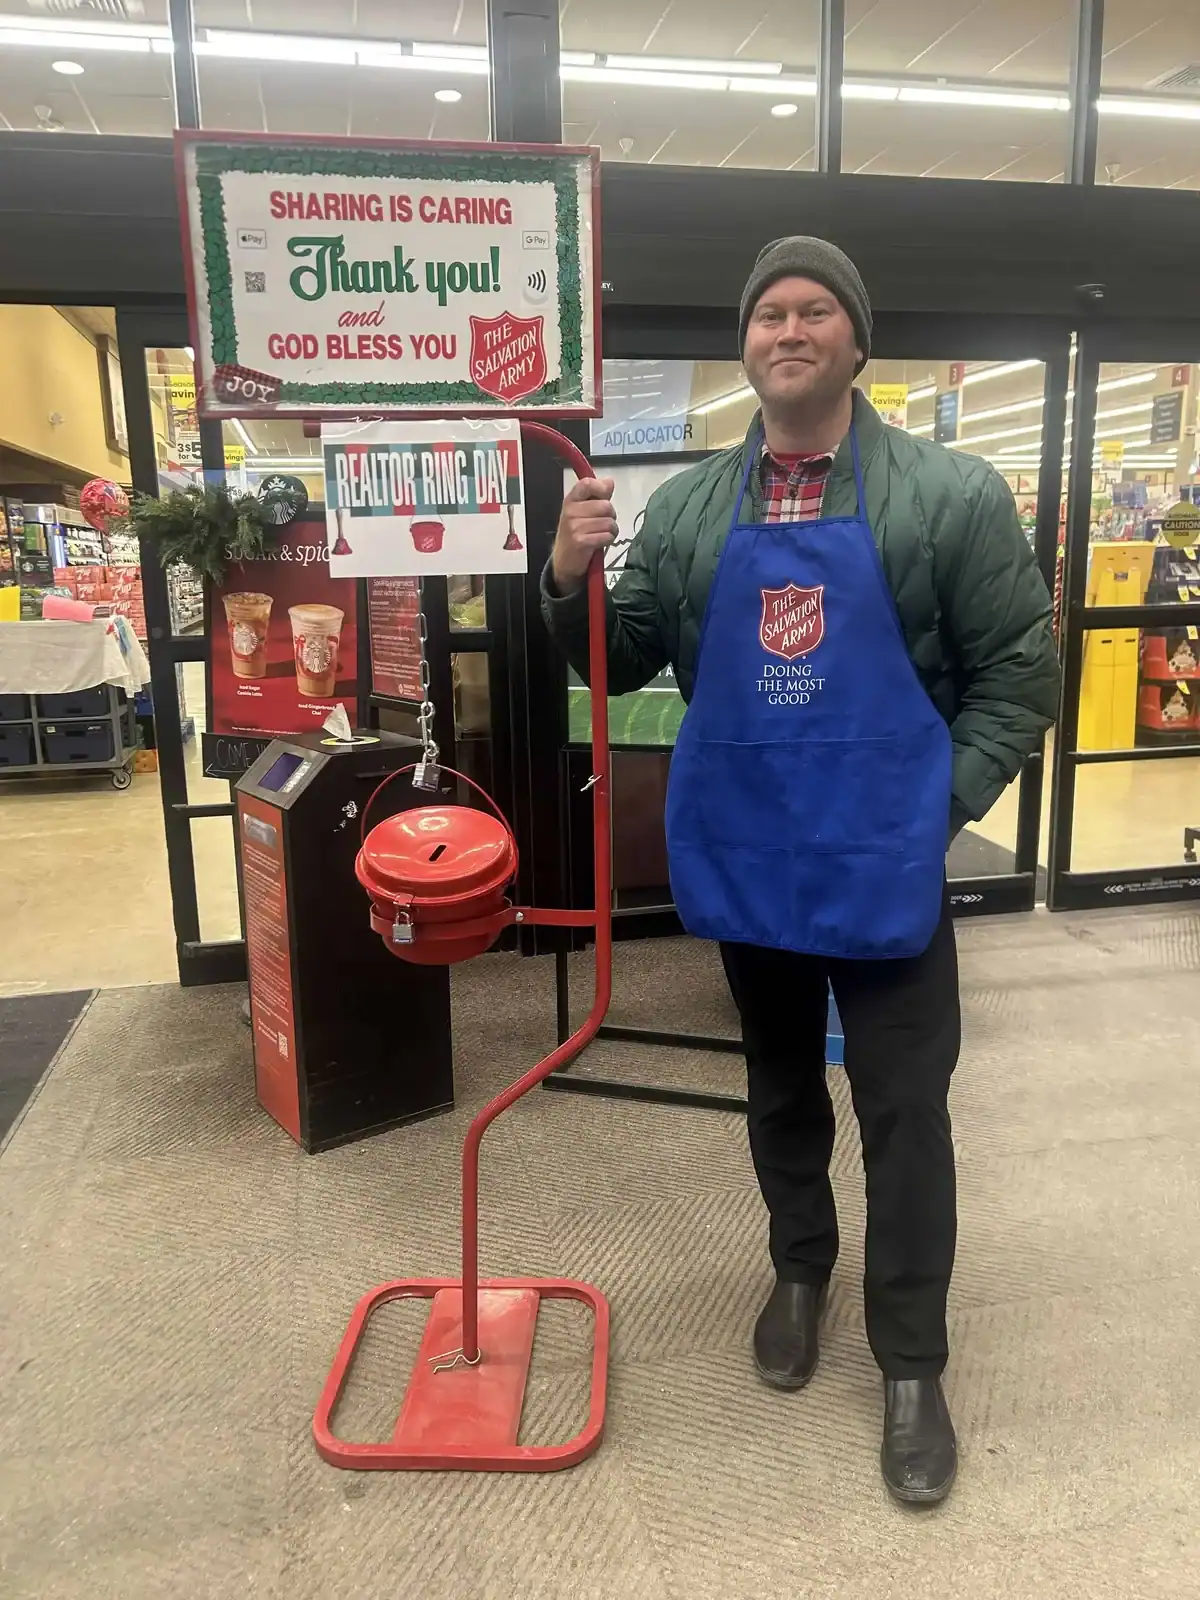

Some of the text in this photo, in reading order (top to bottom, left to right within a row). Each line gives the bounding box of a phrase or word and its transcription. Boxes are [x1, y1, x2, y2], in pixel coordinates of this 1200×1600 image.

[269, 190, 513, 225] SHARING IS CARING
[534, 235, 547, 246] Pay
[287, 234, 501, 306] Thank you!
[338, 300, 385, 327] and
[268, 333, 457, 360] GOD BLESS YOU
[484, 322, 512, 350] THE
[475, 325, 537, 380] SALVATION
[498, 351, 536, 392] ARMY
[226, 375, 275, 402] JOY
[421, 450, 469, 505] RING
[473, 449, 509, 504] DAY
[280, 544, 293, 561] &
[295, 540, 332, 567] spic
[764, 592, 818, 641] SALVATION
[772, 591, 797, 616] THE
[781, 615, 817, 651] ARMY
[763, 665, 812, 677] DOING
[756, 678, 825, 692] THE MOST
[768, 692, 810, 705] GOOD
